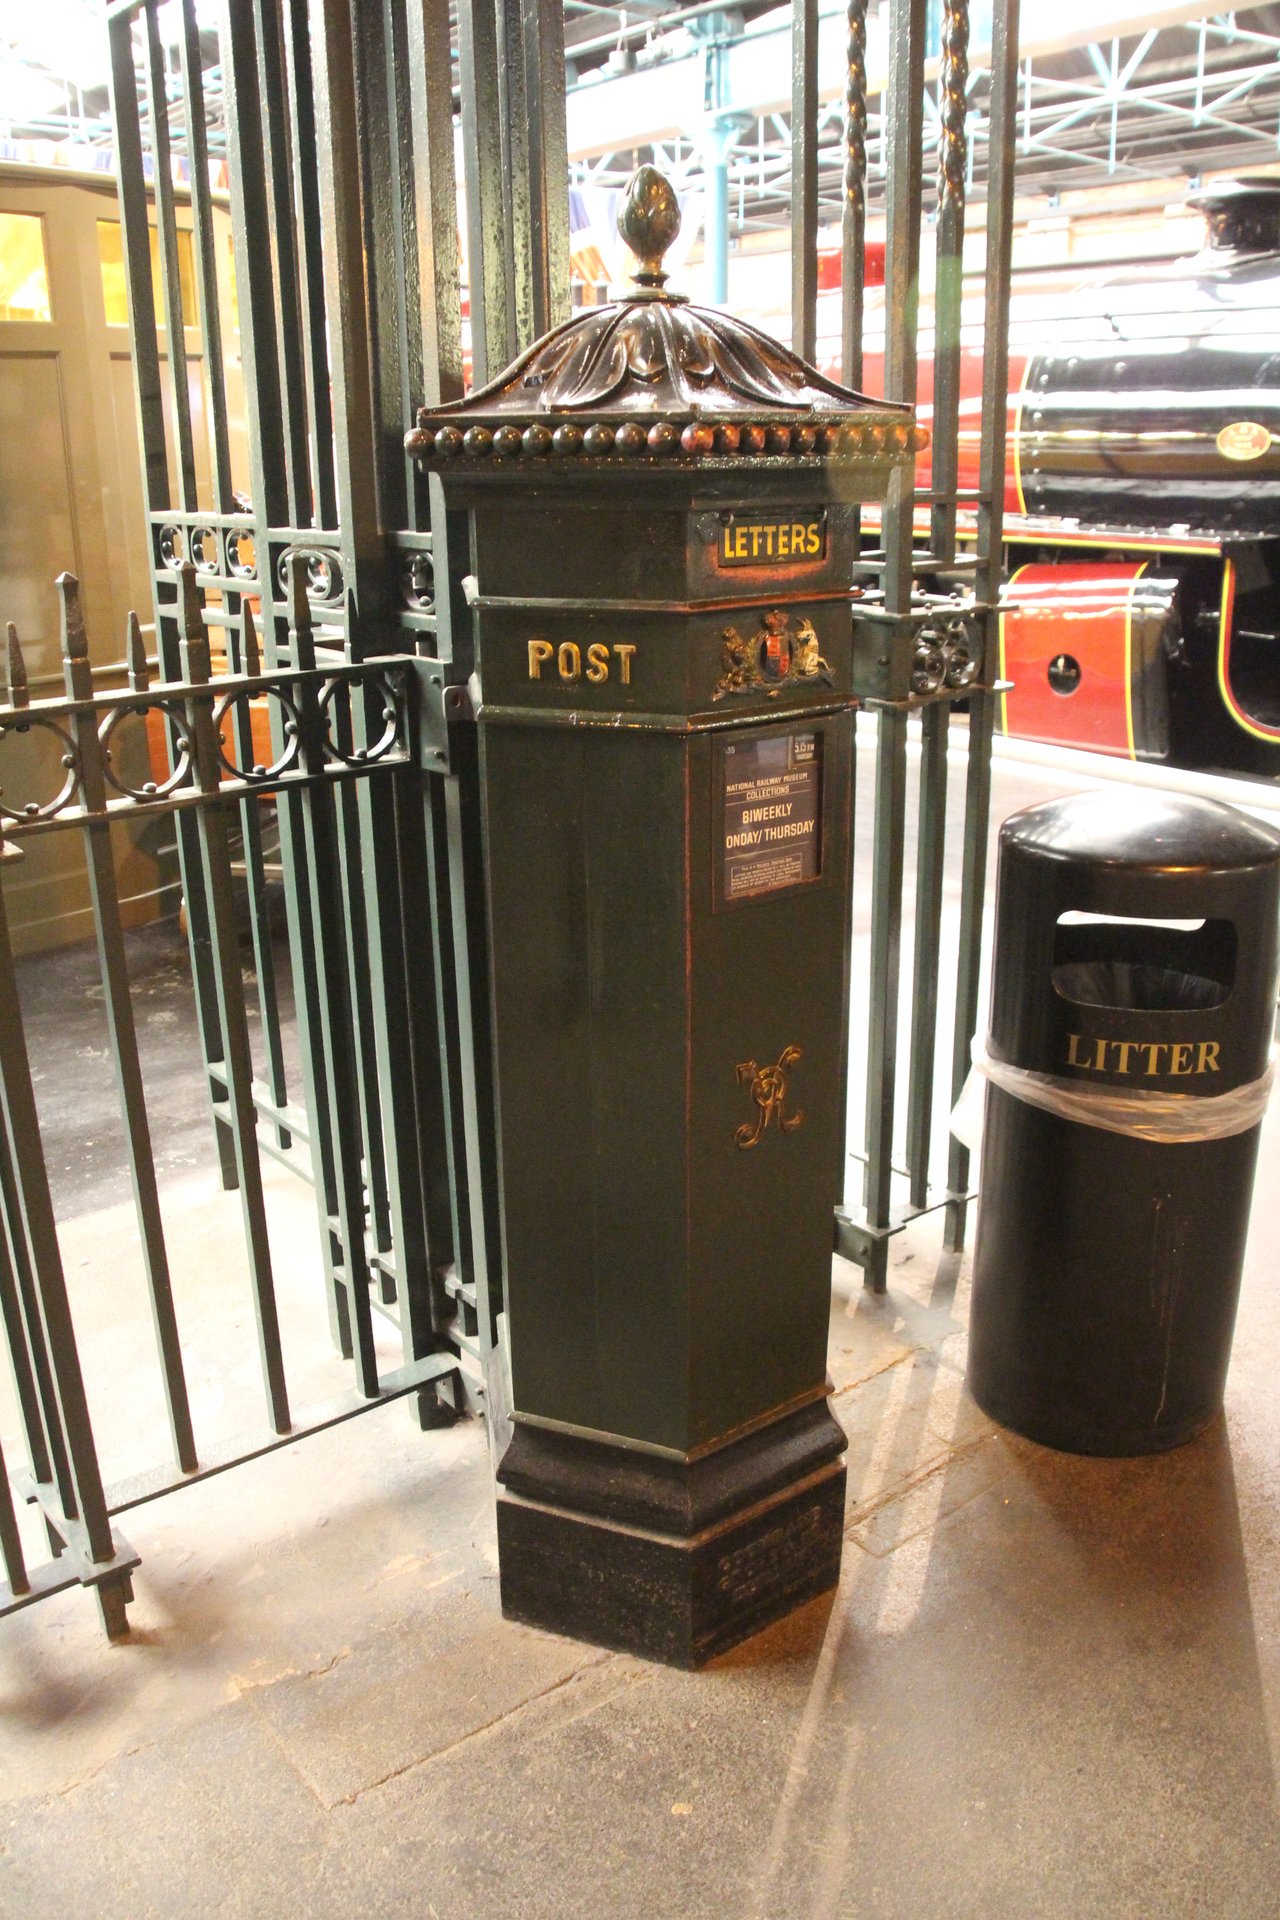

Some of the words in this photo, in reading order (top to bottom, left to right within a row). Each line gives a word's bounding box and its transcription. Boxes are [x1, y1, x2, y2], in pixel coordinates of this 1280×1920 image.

[724, 521, 821, 559] LETTERS
[527, 639, 636, 685] POST
[726, 781, 755, 793] NATIONAL
[756, 776, 783, 788] RAILWAY
[783, 772, 808, 783] MUSEUM
[746, 785, 790, 800] COLLECTIONS
[742, 803, 793, 824] BIWEEKLY
[726, 828, 763, 849] ONDAY/
[764, 820, 815, 841] THURSDAY
[1065, 1033, 1222, 1076] LITTER
